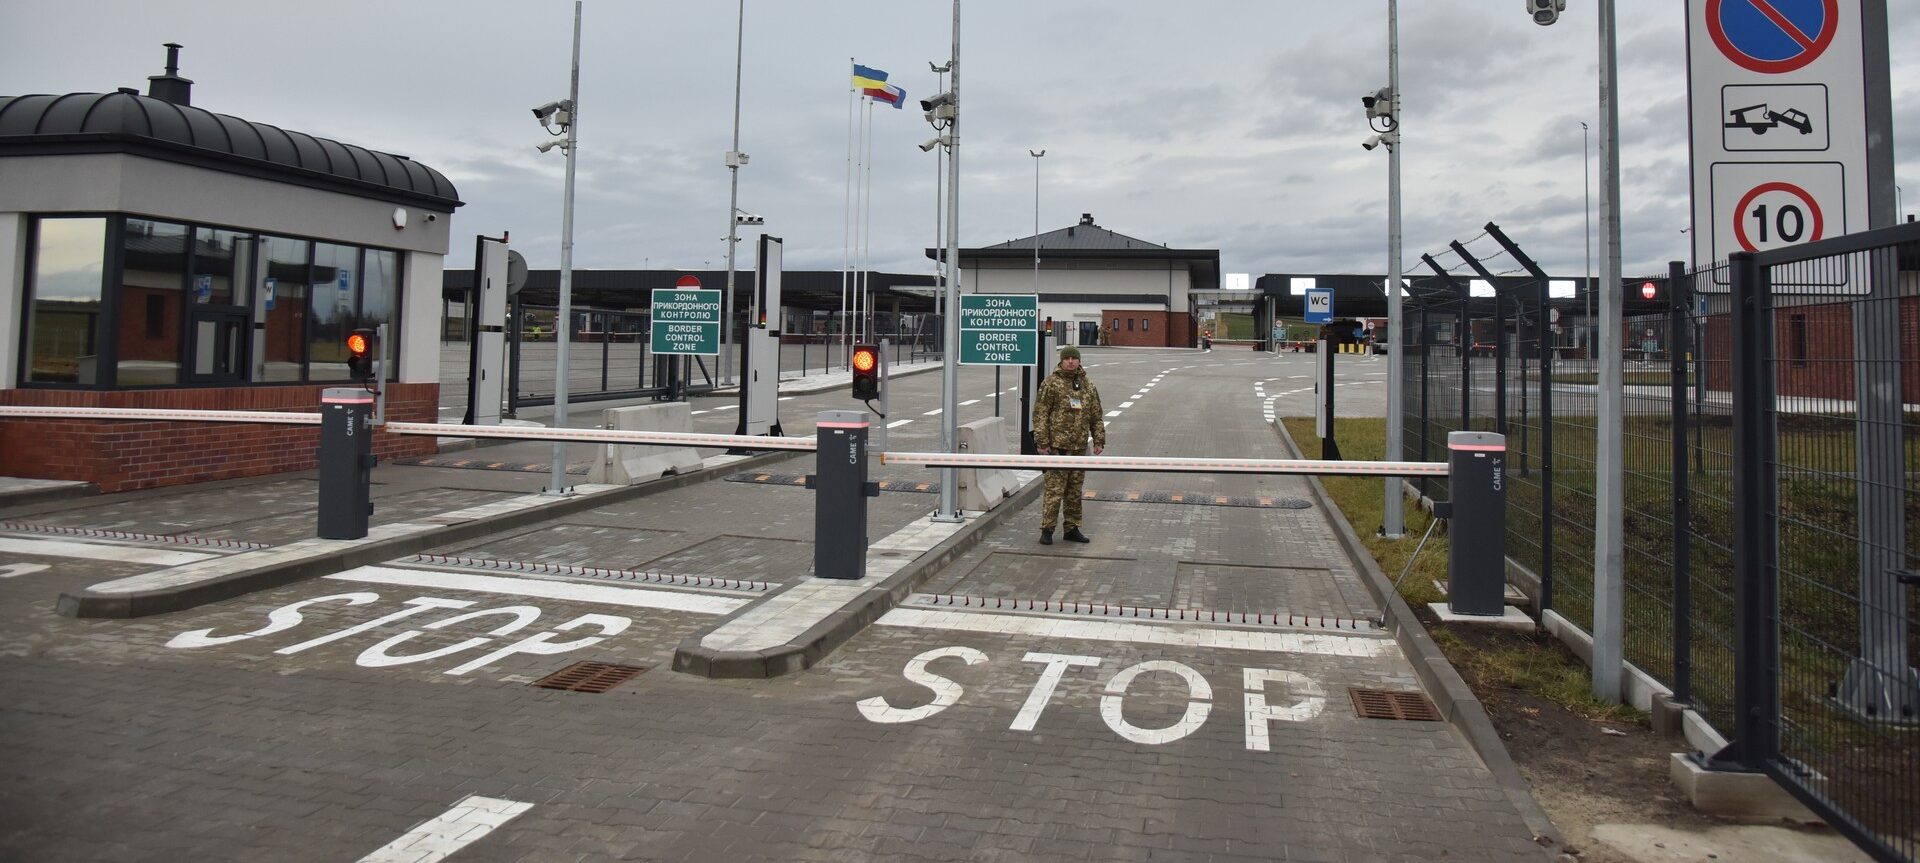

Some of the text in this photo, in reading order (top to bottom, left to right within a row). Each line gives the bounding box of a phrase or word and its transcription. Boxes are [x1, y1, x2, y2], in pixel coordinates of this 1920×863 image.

[1752, 204, 1804, 243] 10
[674, 293, 698, 301] ЗОНА
[1310, 296, 1328, 306] WC
[653, 302, 719, 310] ПРИКОРДОННОГО
[985, 299, 1012, 307] ЗОНА
[660, 311, 711, 319] КОНТРОЛЮ
[961, 308, 1035, 318] ПРИКОРДОННОГО
[970, 318, 1027, 327] КОНТРОЛЮ
[668, 325, 702, 333] BORDER
[665, 334, 704, 342] CONTROL
[979, 333, 1018, 341] BORDER
[673, 343, 696, 351] ZONE
[975, 343, 1021, 351] CONTROL
[984, 353, 1011, 361] ZONE
[346, 416, 354, 437] CAME
[849, 442, 857, 465] CAME
[1493, 467, 1501, 491] CAME
[165, 592, 632, 676] STOP
[856, 646, 1326, 751] STOP
